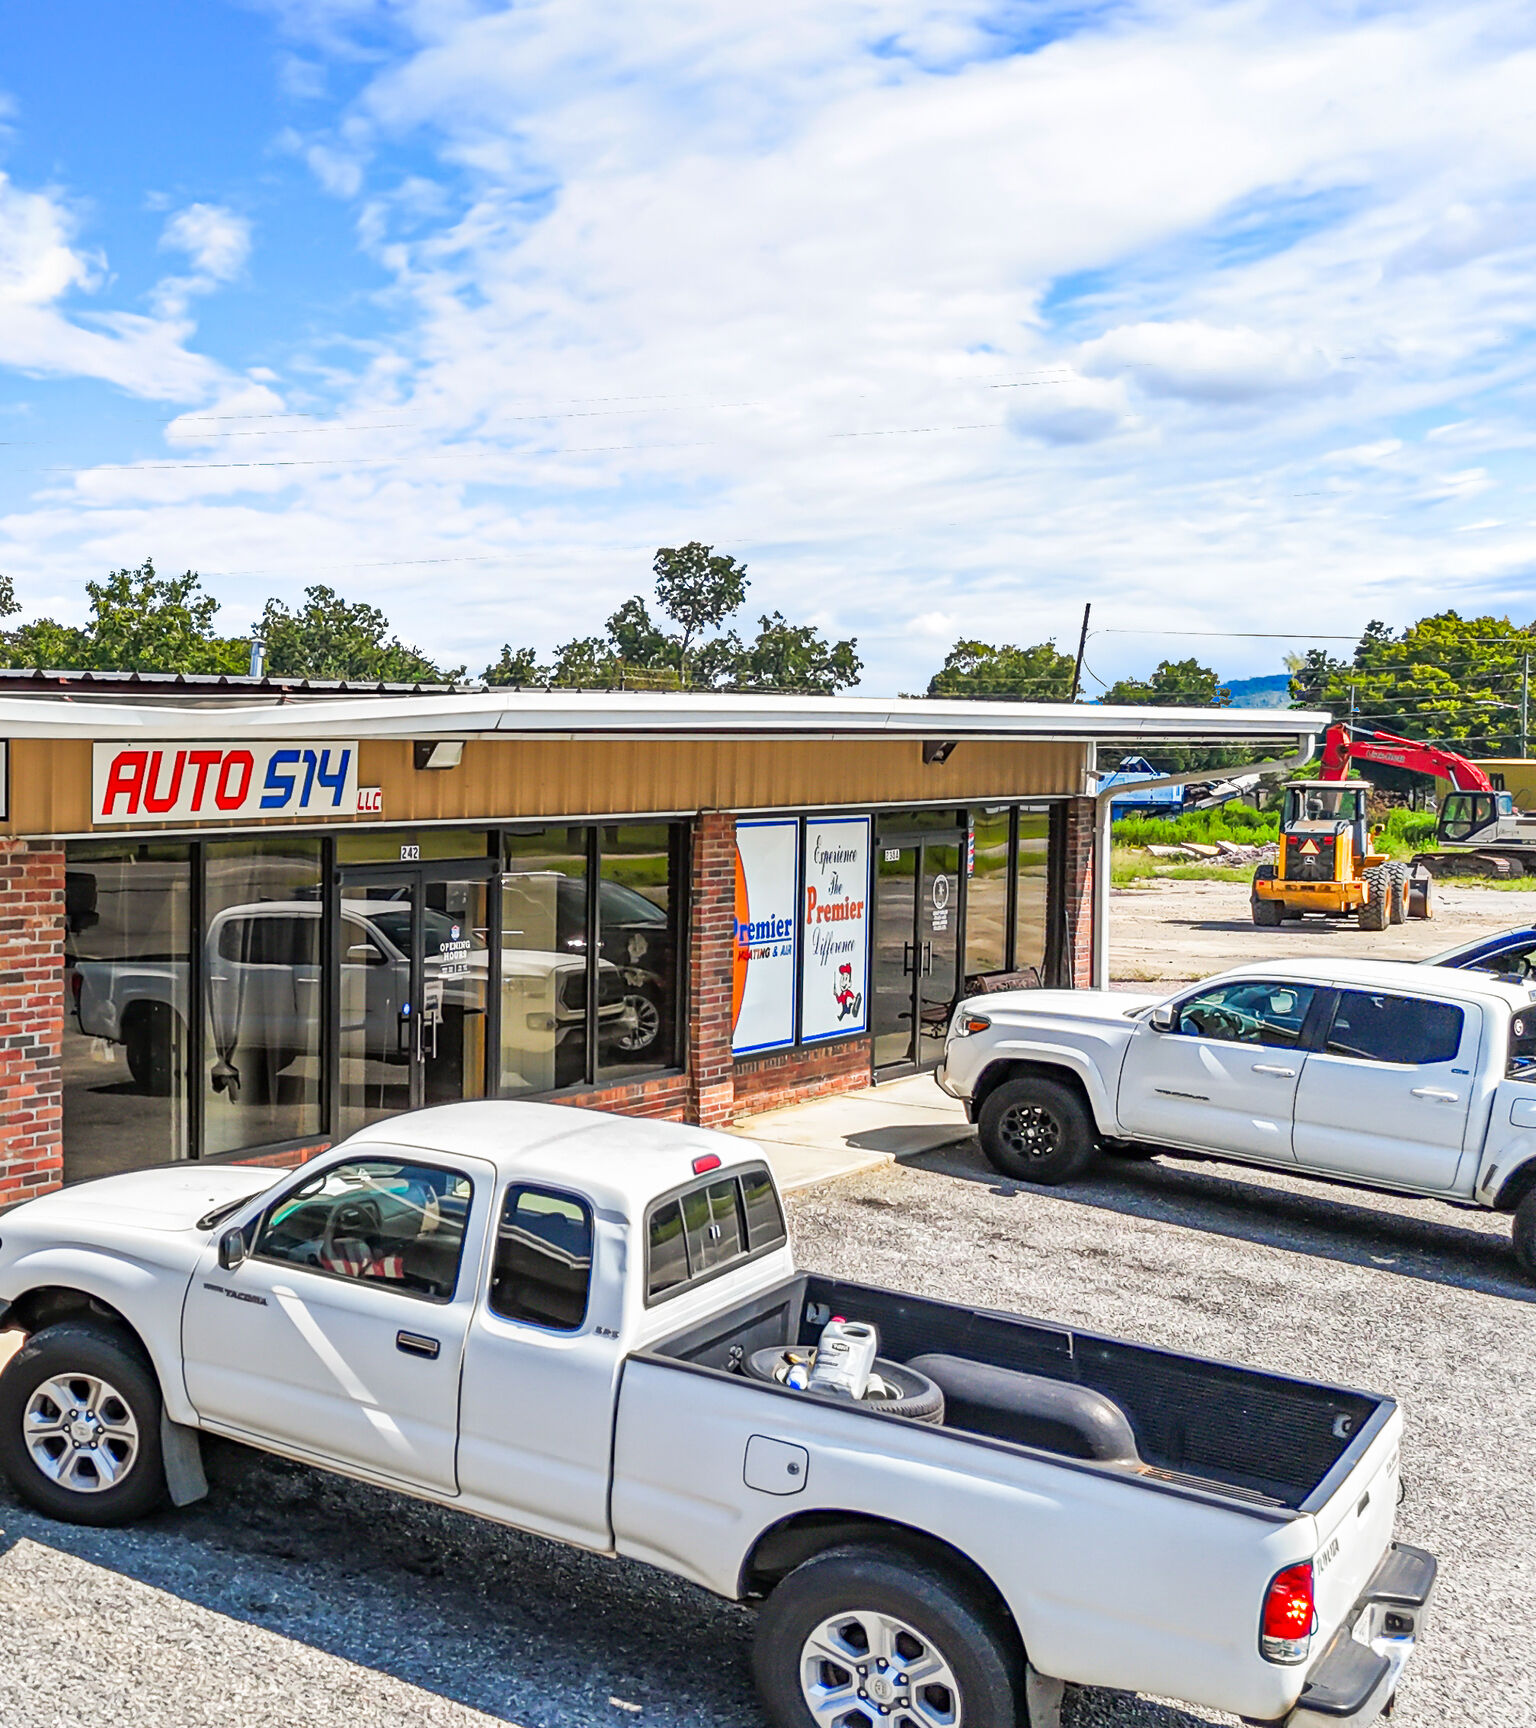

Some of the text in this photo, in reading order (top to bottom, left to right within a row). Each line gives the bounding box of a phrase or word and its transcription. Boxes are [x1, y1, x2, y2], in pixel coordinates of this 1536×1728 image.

[102, 750, 254, 815] AUTO
[357, 792, 382, 811] LLC
[401, 847, 419, 859] 242
[814, 835, 857, 875] Experience
[828, 871, 842, 895] The
[807, 886, 863, 924] Premier
[440, 940, 471, 952] OPENING
[443, 950, 467, 961] HOURS
[813, 927, 855, 966] Difference
